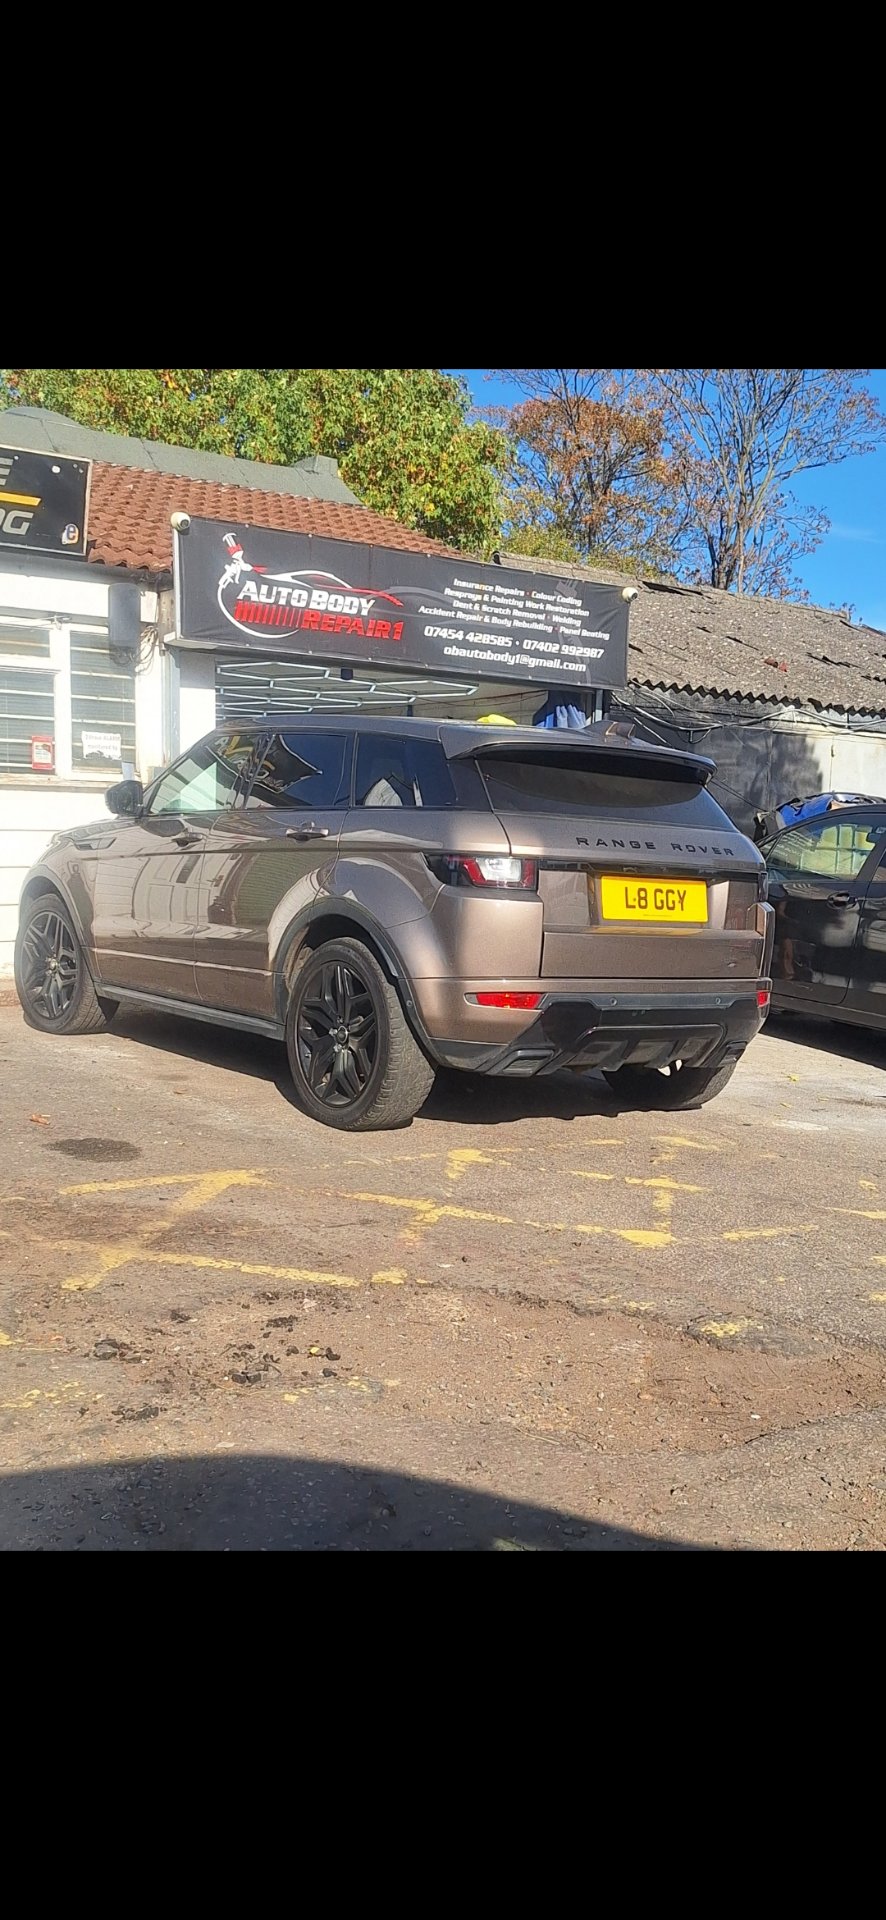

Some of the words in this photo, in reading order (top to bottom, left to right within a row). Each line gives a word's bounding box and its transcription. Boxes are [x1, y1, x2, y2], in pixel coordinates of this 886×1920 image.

[444, 587, 482, 601] Resprays
[483, 594, 489, 602] &
[490, 595, 524, 608] Painting
[525, 600, 545, 610] Work
[545, 604, 590, 617] Restoration
[453, 578, 494, 592] Insurance
[494, 585, 525, 597] Repairs
[531, 591, 556, 602] Colour
[556, 596, 582, 607] Coding
[418, 606, 456, 618] Accident
[456, 611, 484, 622] Repair
[484, 615, 490, 623] &
[491, 616, 512, 628] Body
[512, 619, 553, 633] Rebuilding
[559, 626, 581, 636] Panel
[581, 629, 611, 641] Beating
[453, 600, 473, 609] Dent
[481, 604, 511, 616] Scratch
[512, 609, 546, 621] Removal
[552, 615, 582, 627] Welding
[424, 625, 465, 641] 07454
[465, 632, 513, 648] 428585
[522, 639, 560, 654] 07402
[560, 644, 605, 659] 992987
[576, 836, 657, 850] RANGE
[671, 842, 735, 856] ROVER
[624, 886, 648, 909] L8
[653, 889, 687, 912] GGY
